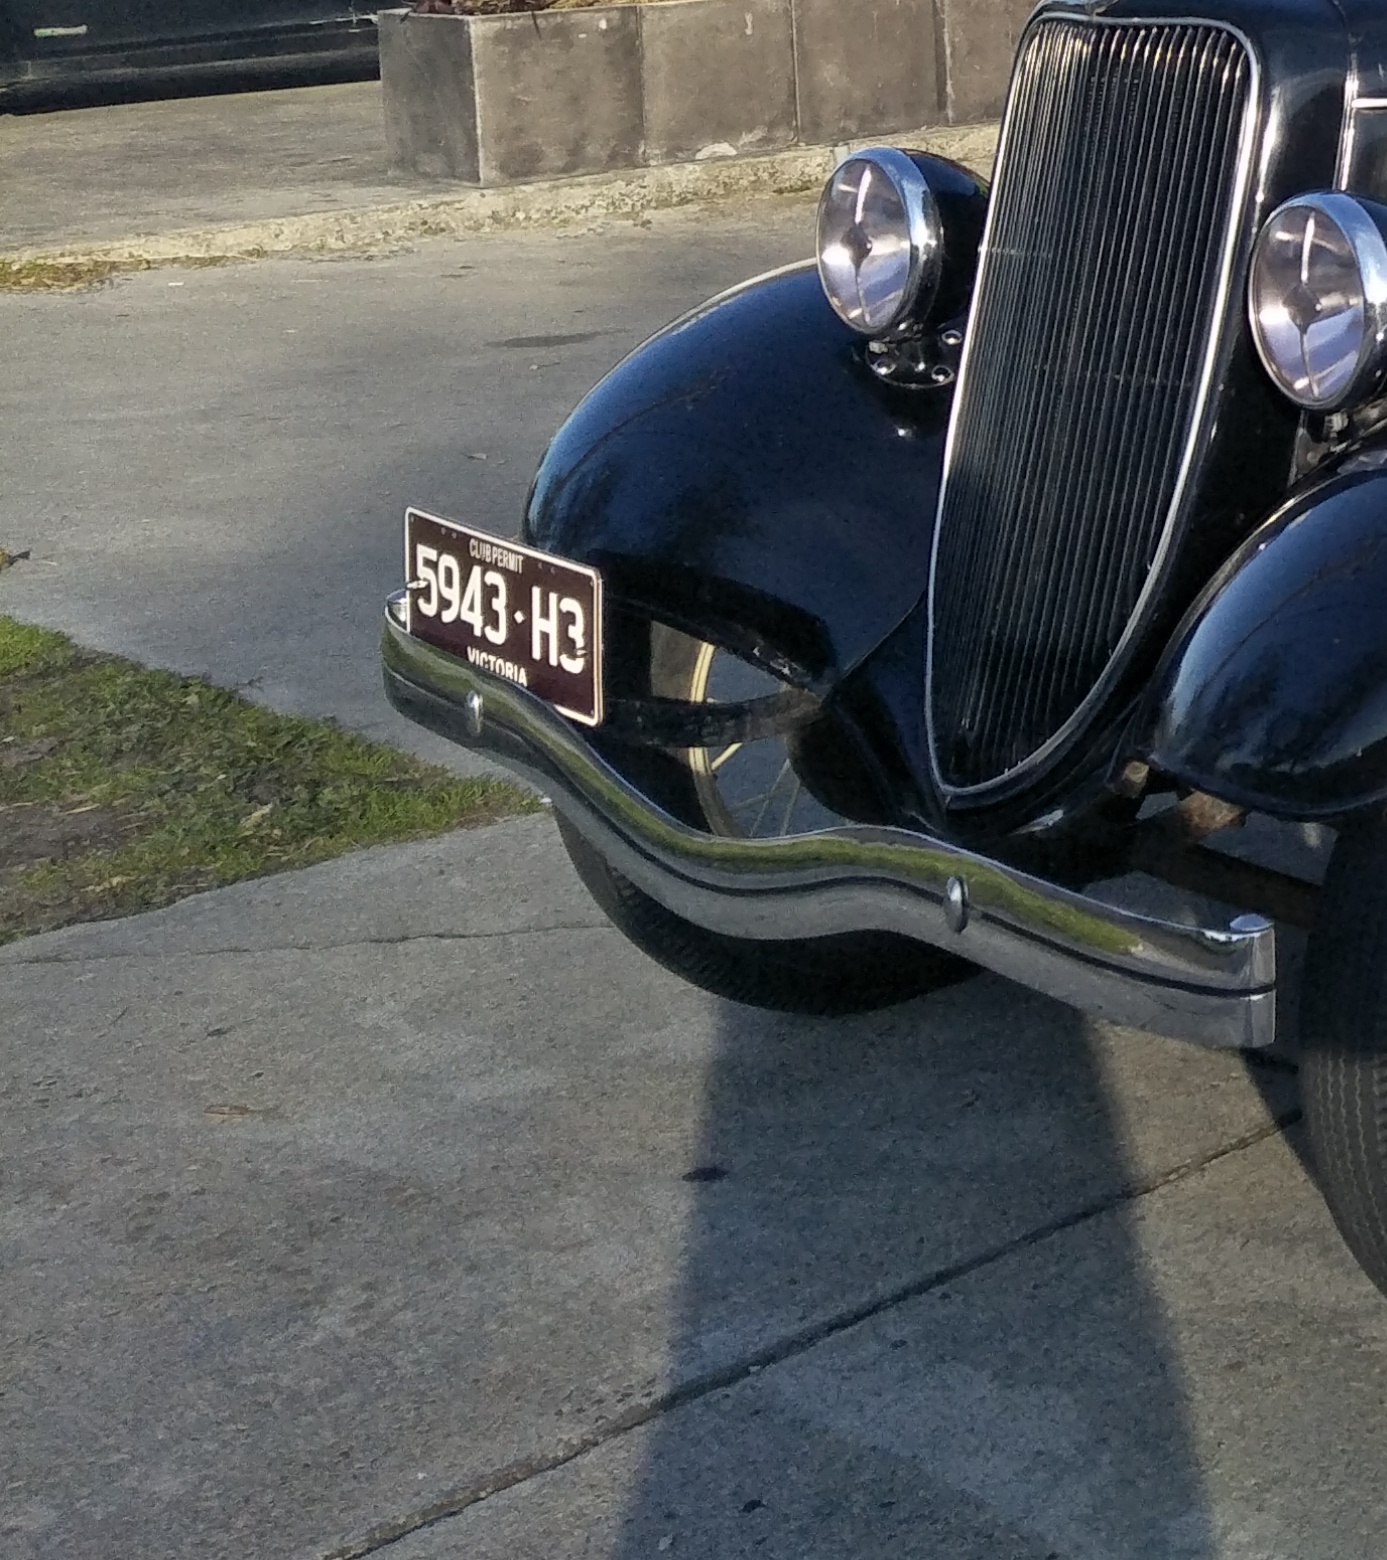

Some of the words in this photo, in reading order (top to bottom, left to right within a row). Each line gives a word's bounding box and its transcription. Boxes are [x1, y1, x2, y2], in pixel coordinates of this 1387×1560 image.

[469, 538, 492, 563] CLUB
[491, 548, 524, 574] PERMIT
[466, 645, 528, 687] VICTORIA
